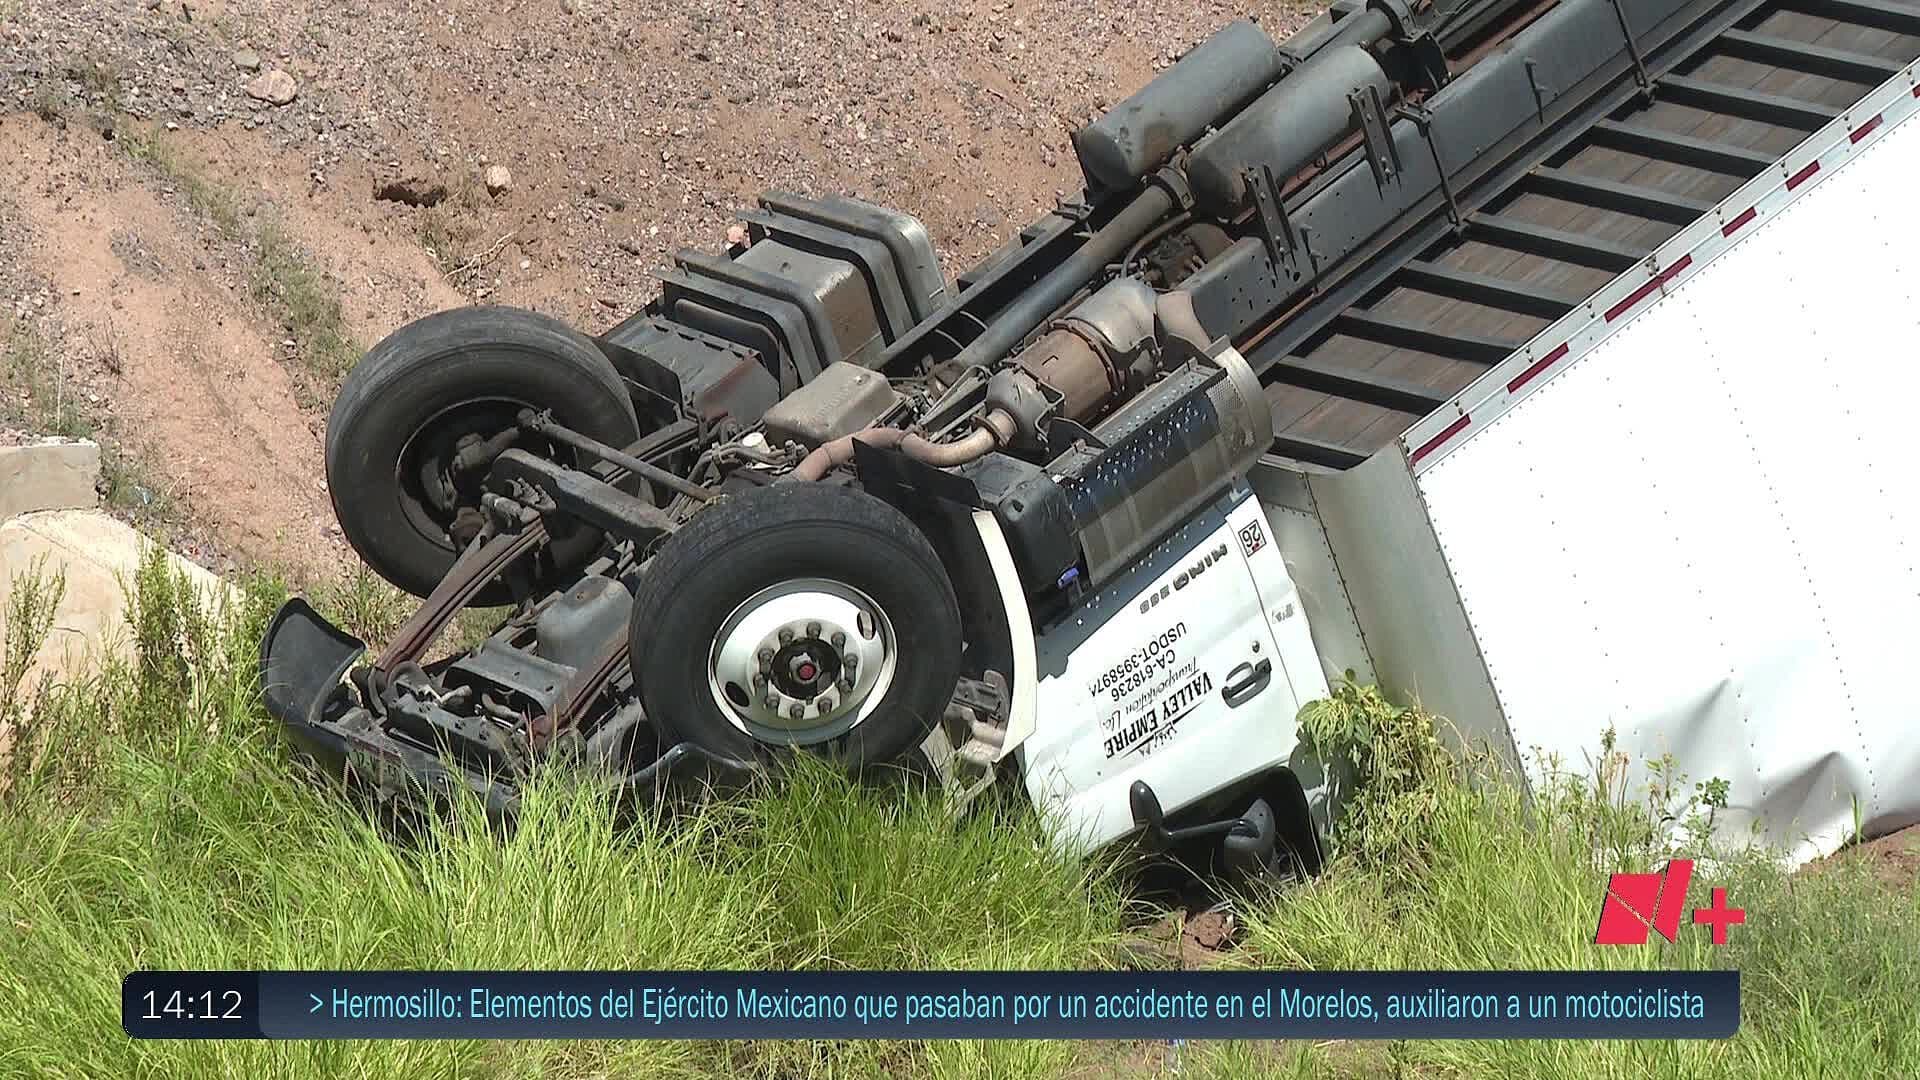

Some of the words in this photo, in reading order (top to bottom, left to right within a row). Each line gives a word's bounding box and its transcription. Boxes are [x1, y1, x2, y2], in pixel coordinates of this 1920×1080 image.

[1242, 523, 1261, 548] 26
[1111, 649, 1176, 702] CA-618236
[1162, 671, 1213, 721] VALLEY
[1103, 708, 1159, 760] EMPIRE
